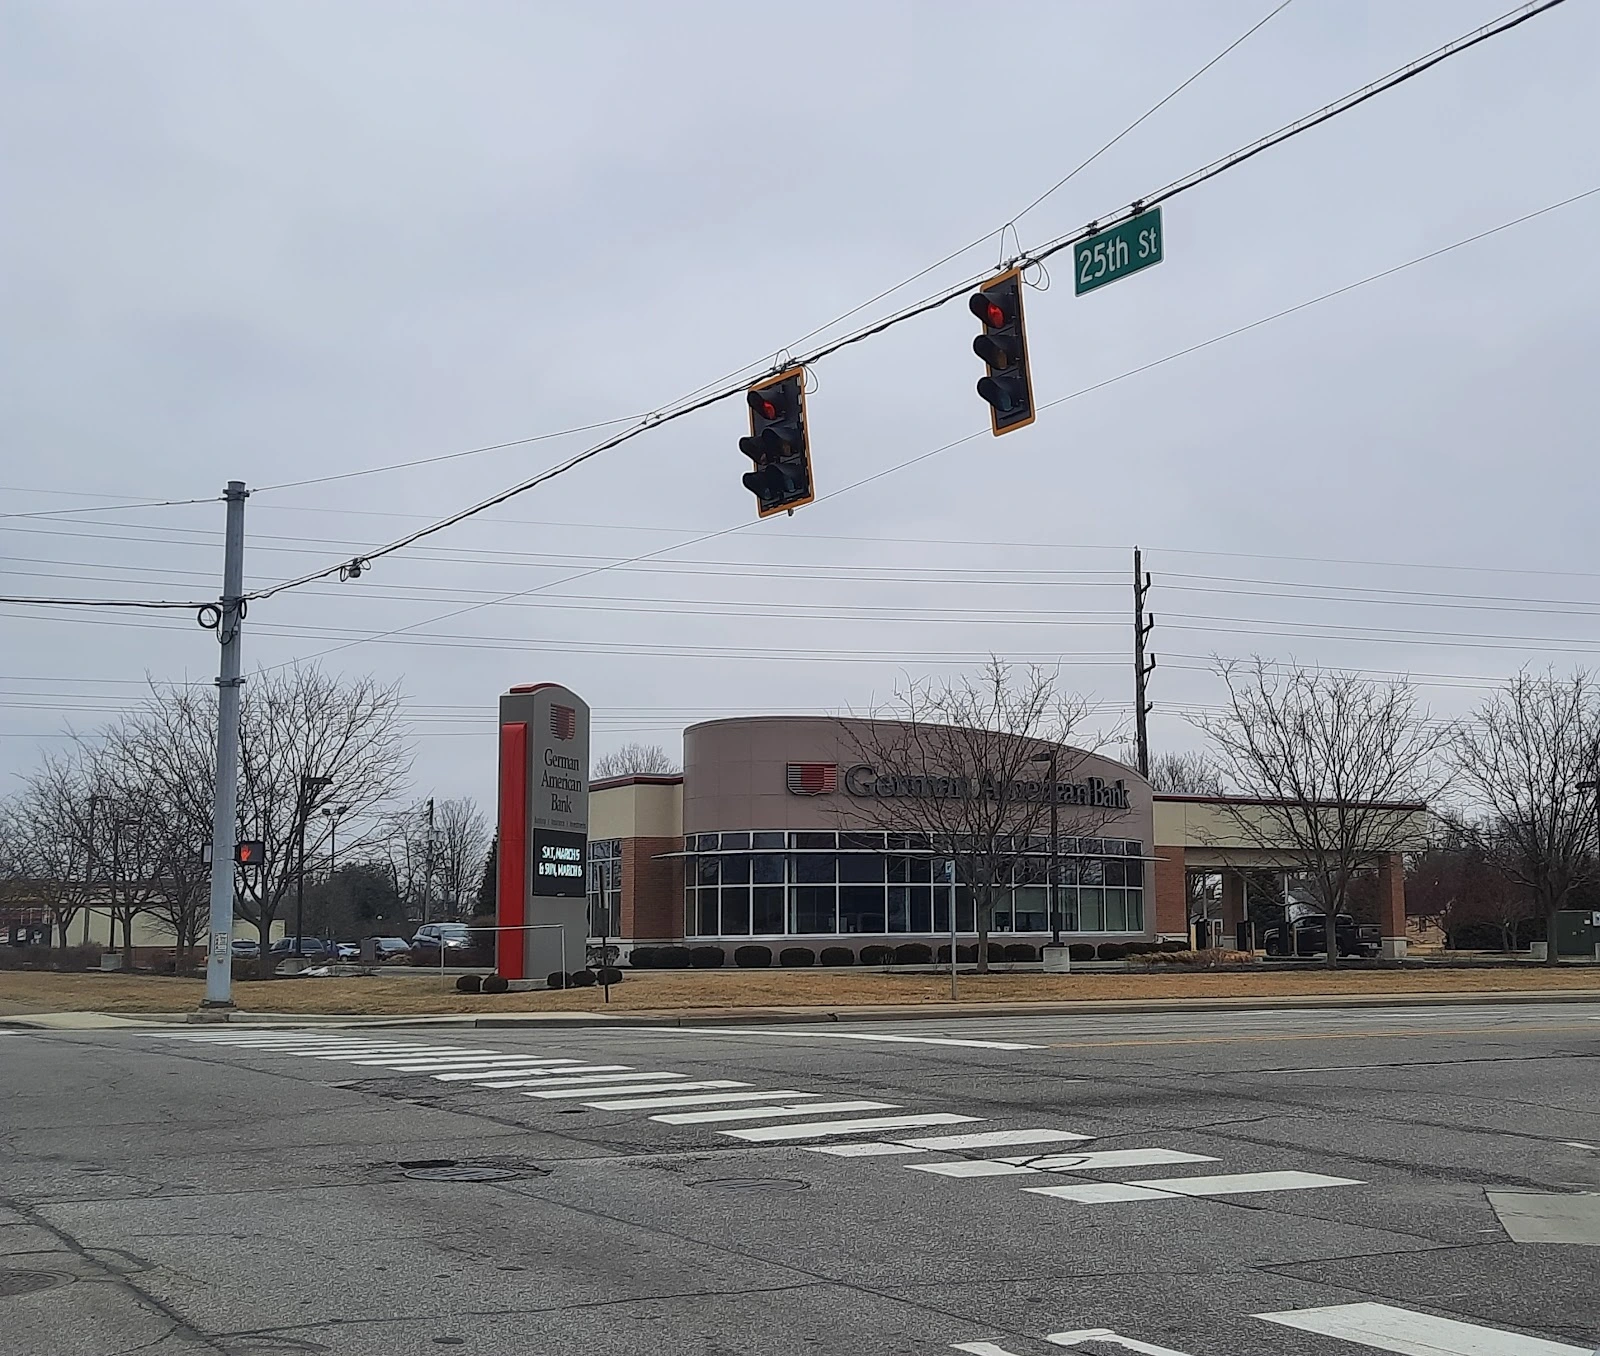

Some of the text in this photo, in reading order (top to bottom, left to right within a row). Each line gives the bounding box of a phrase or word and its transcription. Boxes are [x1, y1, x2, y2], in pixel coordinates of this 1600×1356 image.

[1079, 226, 1158, 284] 25th St
[544, 748, 580, 771] German
[541, 769, 582, 792] American
[551, 793, 572, 813] Bank
[1088, 776, 1132, 809] Bank
